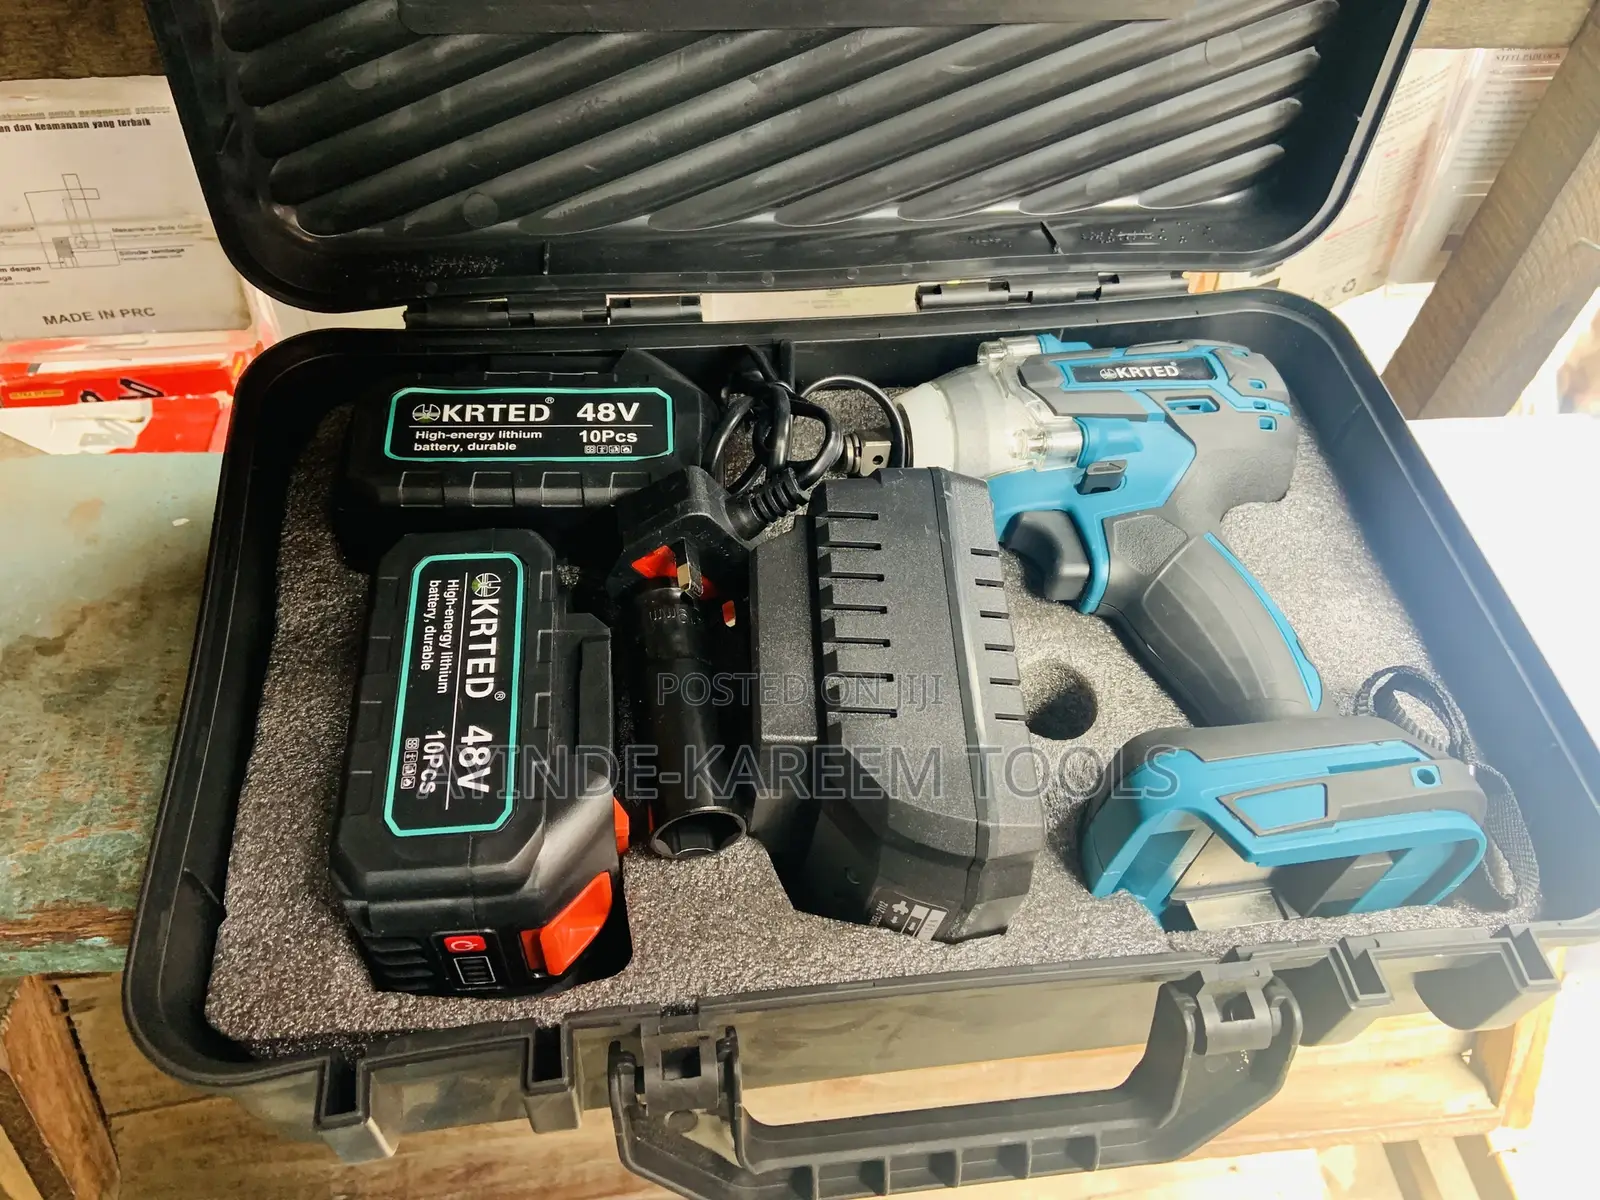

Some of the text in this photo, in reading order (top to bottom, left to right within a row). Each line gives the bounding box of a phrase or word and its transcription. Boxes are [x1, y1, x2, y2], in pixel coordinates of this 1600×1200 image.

[92, 119, 115, 129] yang
[118, 118, 152, 127] terbaik
[42, 306, 157, 326] MADE IN PRC
[577, 402, 640, 422] 48V
[415, 430, 543, 441] High-energy lithium
[579, 430, 638, 443] 10Pcs
[414, 441, 517, 453] battery, durable
[420, 580, 442, 671] battery, durable
[436, 579, 460, 694] High-energy lithium
[457, 725, 493, 793] 48V
